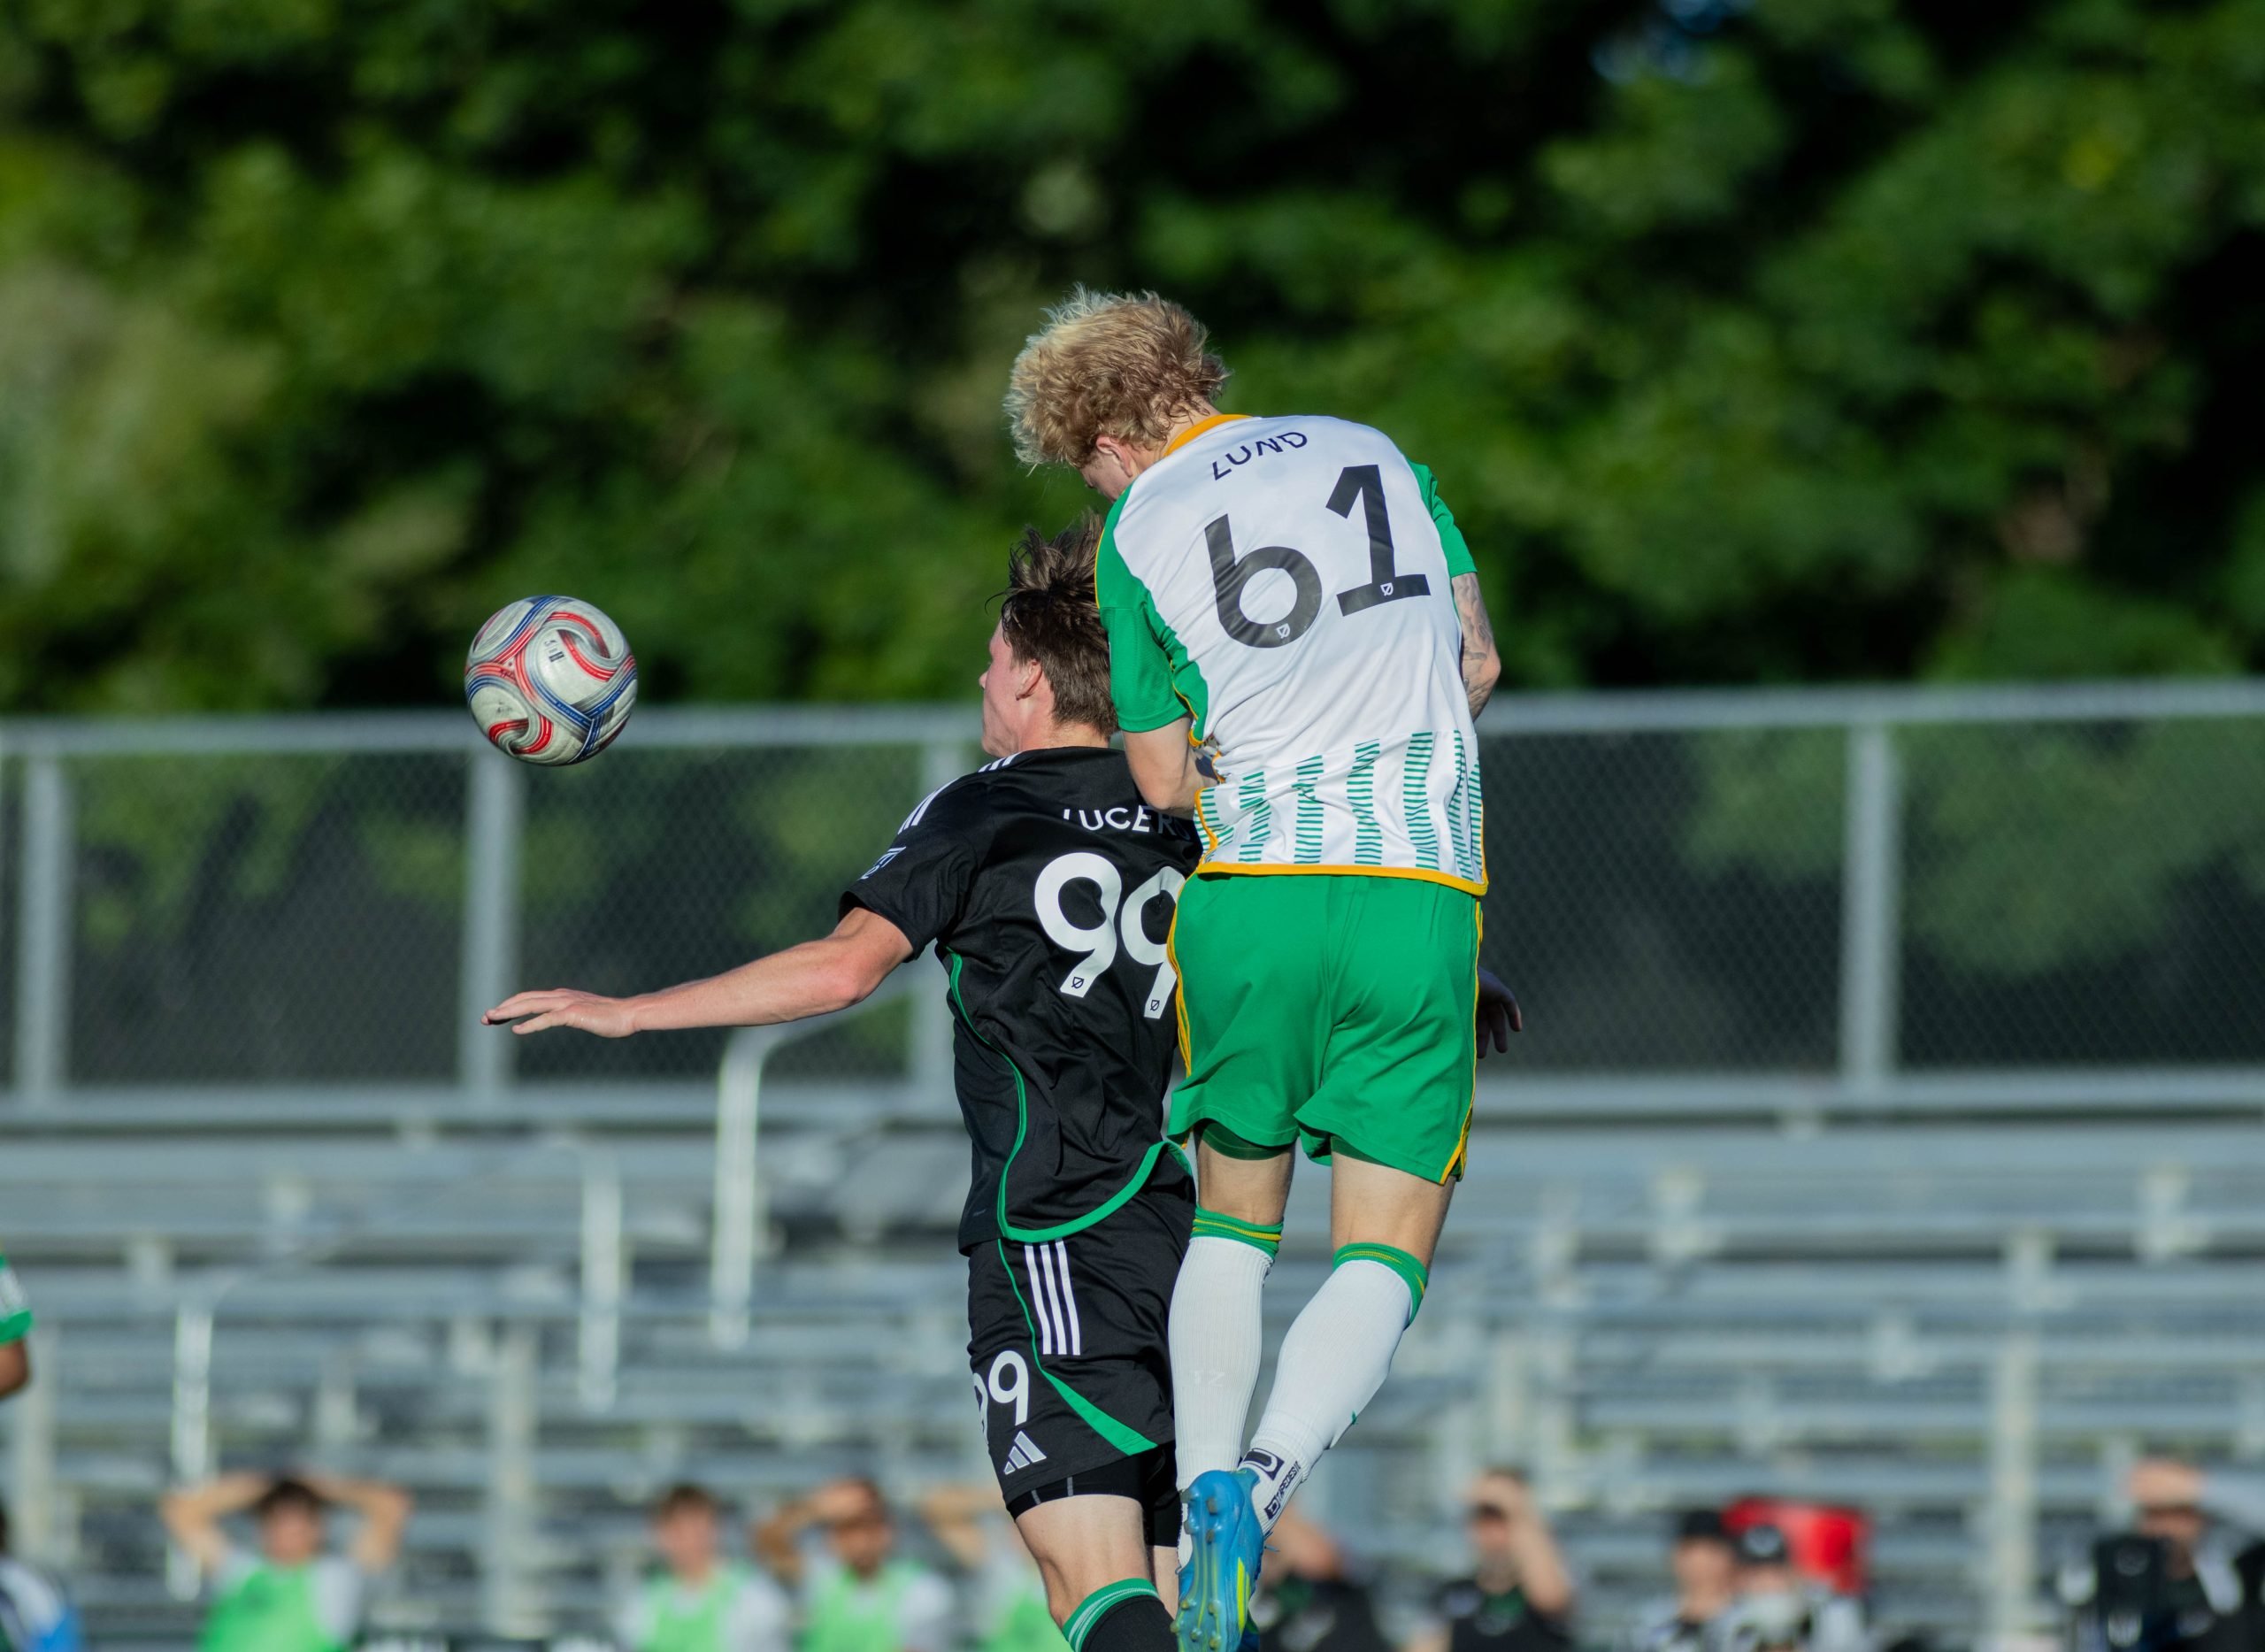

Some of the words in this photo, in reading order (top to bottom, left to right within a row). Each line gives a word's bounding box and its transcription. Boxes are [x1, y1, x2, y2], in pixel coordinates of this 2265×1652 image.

[1212, 431, 1308, 480] LUND
[1204, 464, 1432, 649] 61
[1033, 851, 1187, 1019] 99
